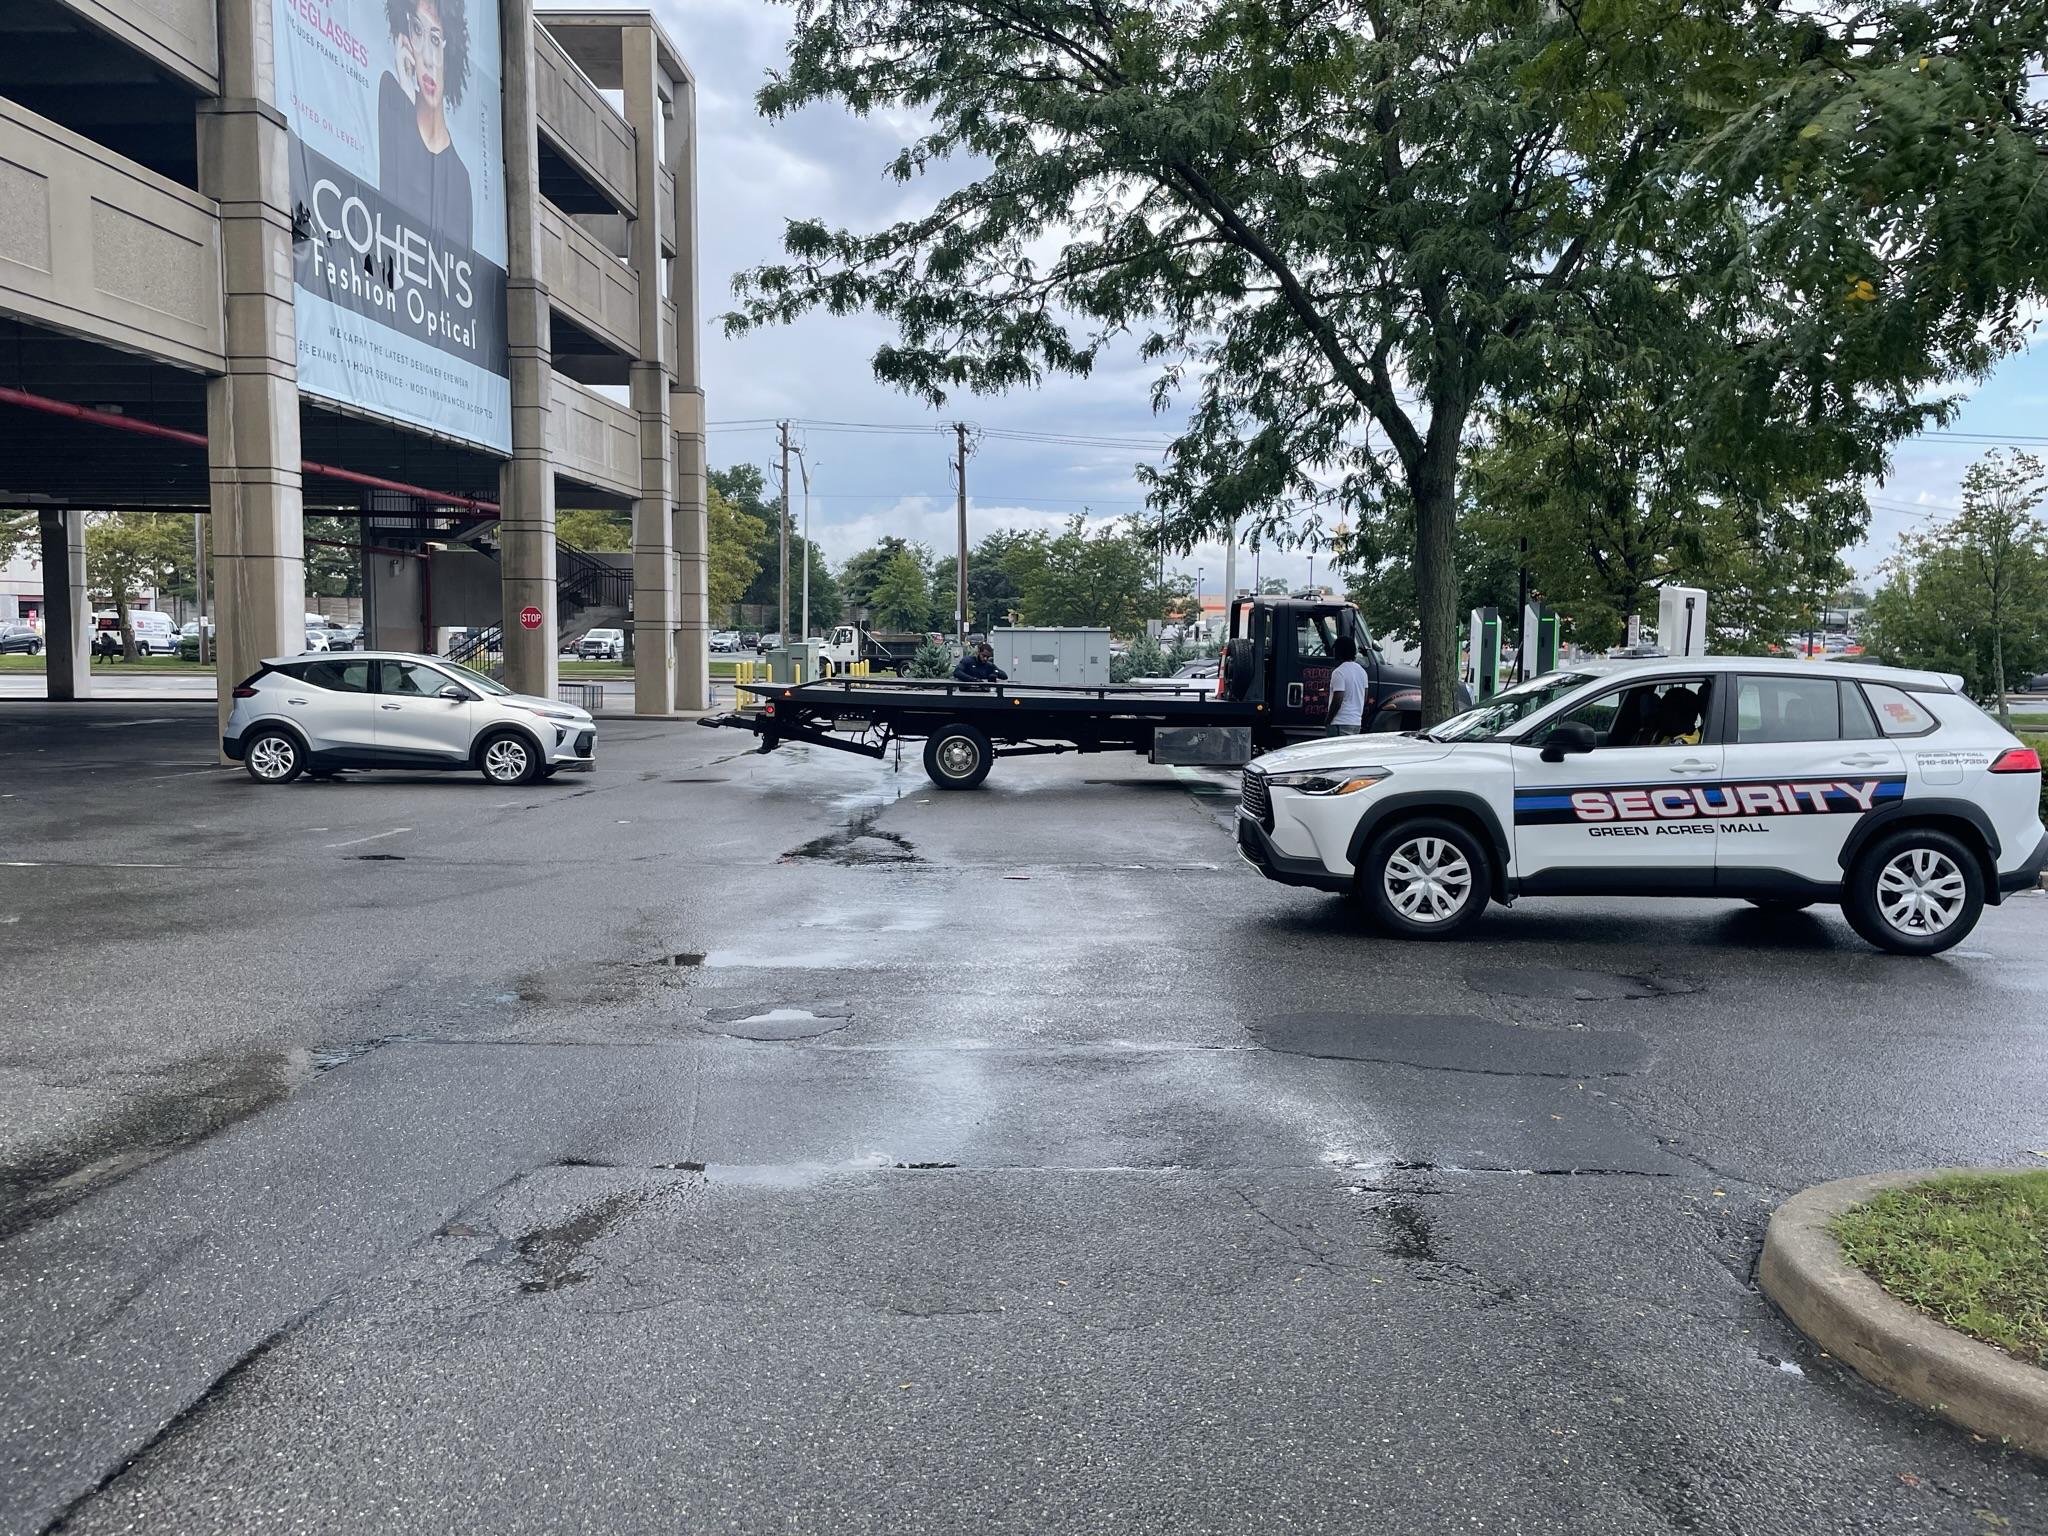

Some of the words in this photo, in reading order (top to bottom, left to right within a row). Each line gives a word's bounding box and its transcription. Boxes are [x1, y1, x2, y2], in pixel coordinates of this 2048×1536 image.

[316, 41, 339, 65] FRAME
[346, 64, 370, 88] LENSES
[312, 178, 473, 308] COHEN'S
[310, 237, 397, 313] Fashion
[406, 288, 478, 350] Optical
[311, 346, 337, 363] EXAMS
[375, 369, 403, 388] SERVICE
[410, 382, 428, 395] MOST
[369, 342, 383, 356] THE
[385, 349, 409, 366] LATEST
[410, 359, 442, 378] DESIGNER
[521, 613, 542, 623] STOP
[1571, 780, 1881, 821] SECURITY
[1588, 826, 1649, 838] GREEN
[1655, 824, 1715, 836] ACRES
[1719, 822, 1770, 834] MALL
